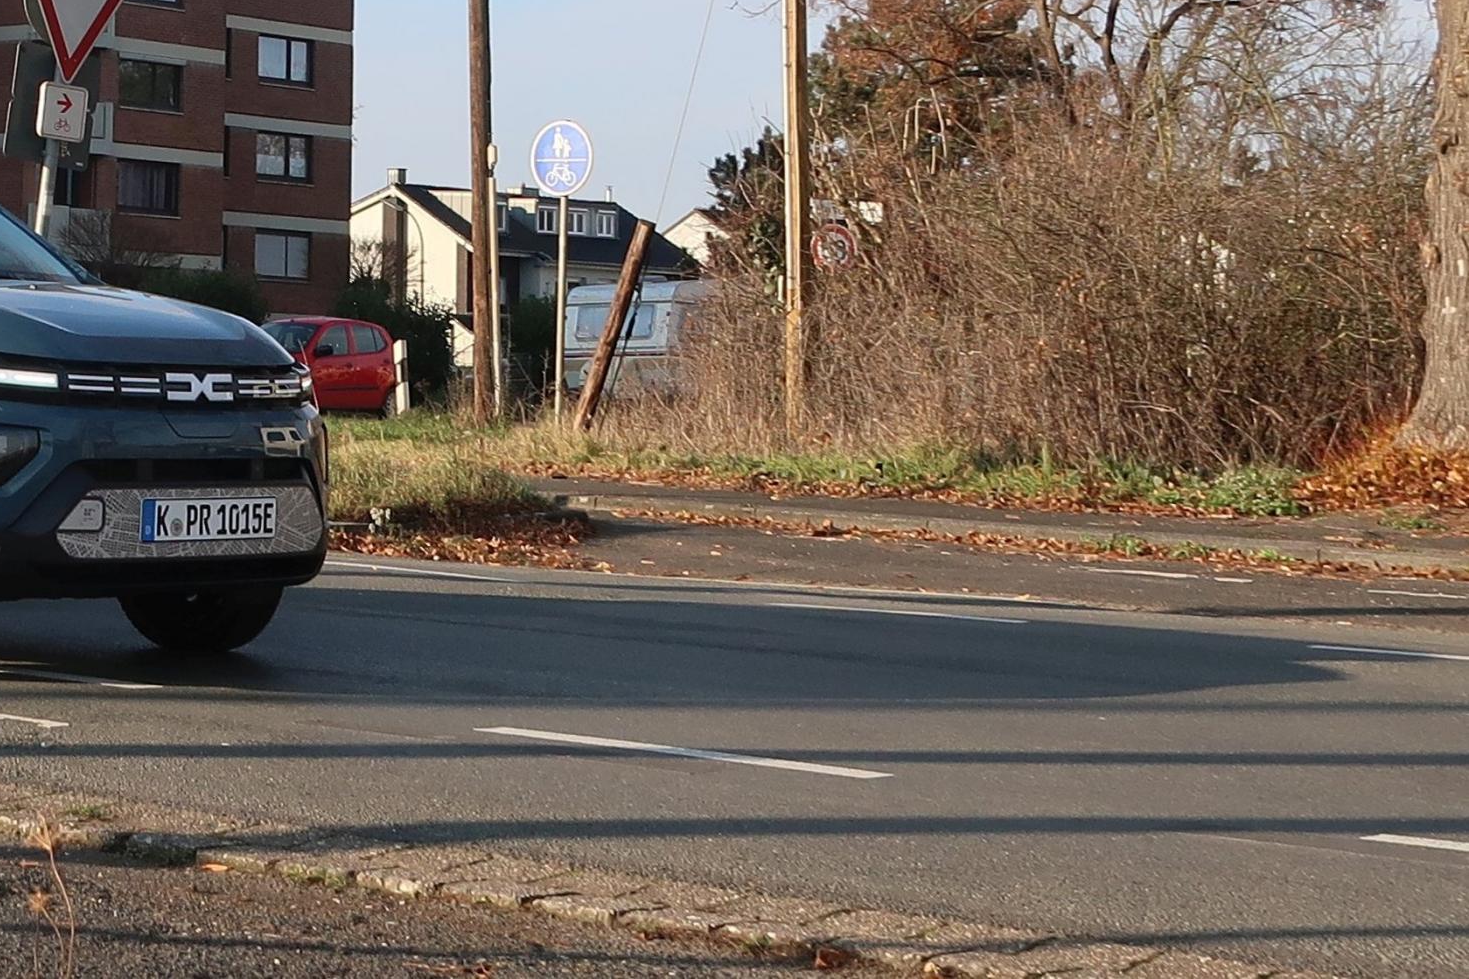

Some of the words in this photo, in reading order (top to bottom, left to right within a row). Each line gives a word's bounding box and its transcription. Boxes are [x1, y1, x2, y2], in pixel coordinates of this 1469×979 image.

[157, 505, 170, 536] K
[186, 504, 211, 536] PR
[216, 503, 274, 535] 1015E
